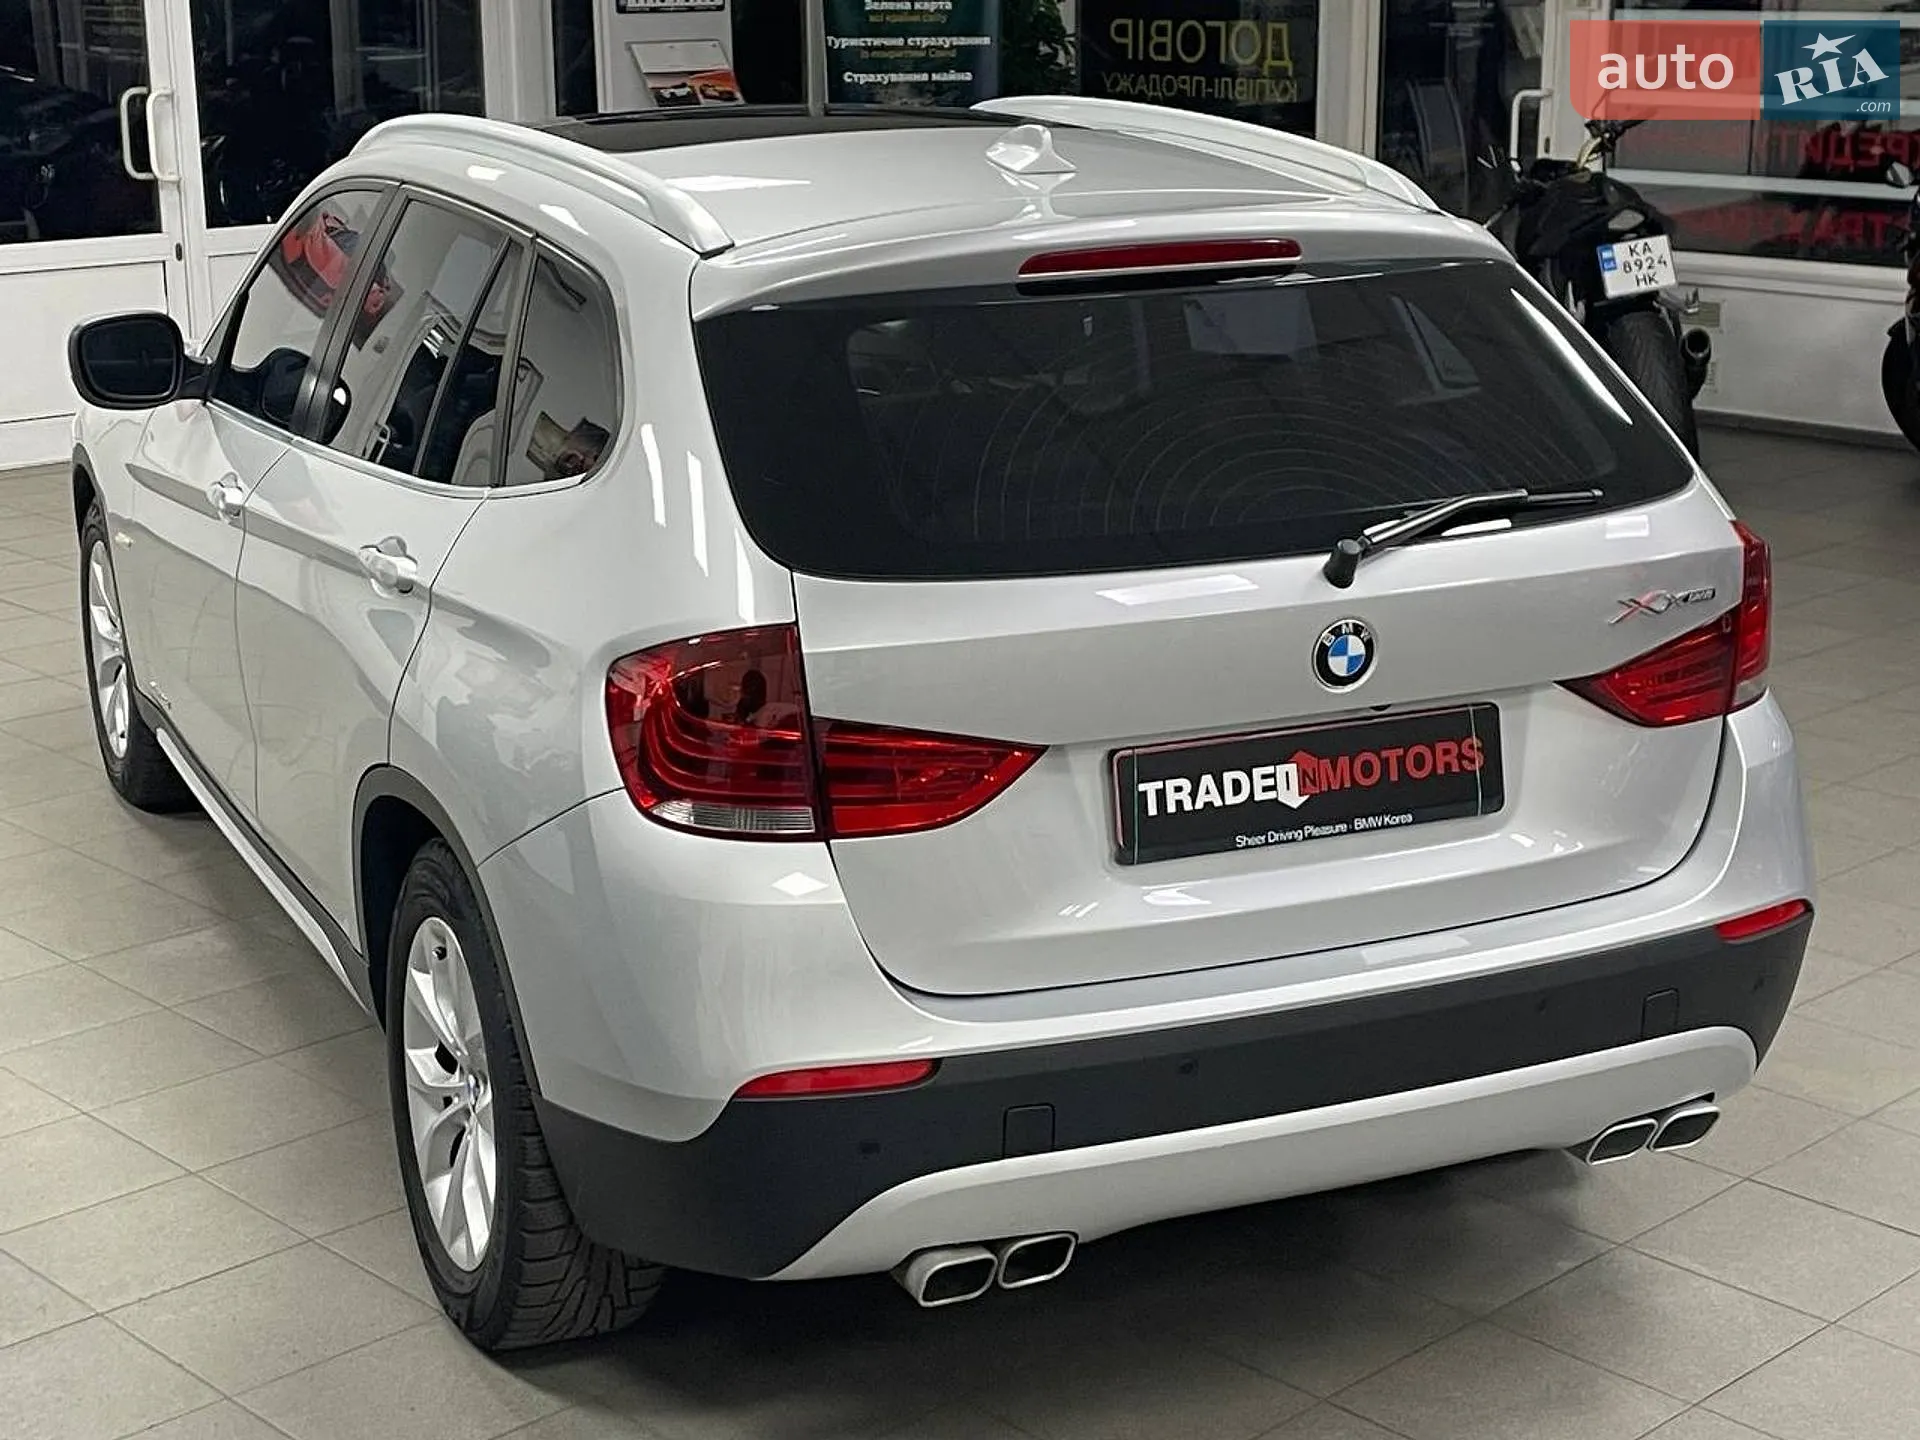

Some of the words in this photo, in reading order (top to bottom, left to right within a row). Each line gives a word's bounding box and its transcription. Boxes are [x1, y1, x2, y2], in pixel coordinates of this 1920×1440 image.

[827, 36, 904, 48] Туристичне
[907, 36, 991, 48] страхування
[843, 71, 928, 84] Страхування
[931, 69, 973, 82] майна
[1628, 241, 1653, 257] KA
[1622, 254, 1668, 274] 8924
[1635, 271, 1659, 287] HK
[1319, 735, 1485, 792] MOTORS
[1235, 834, 1266, 848] Sheer
[1267, 828, 1303, 843] Driving
[1304, 822, 1347, 838] Pleasure
[1354, 815, 1382, 831] BMW
[1383, 812, 1413, 826] Korea
